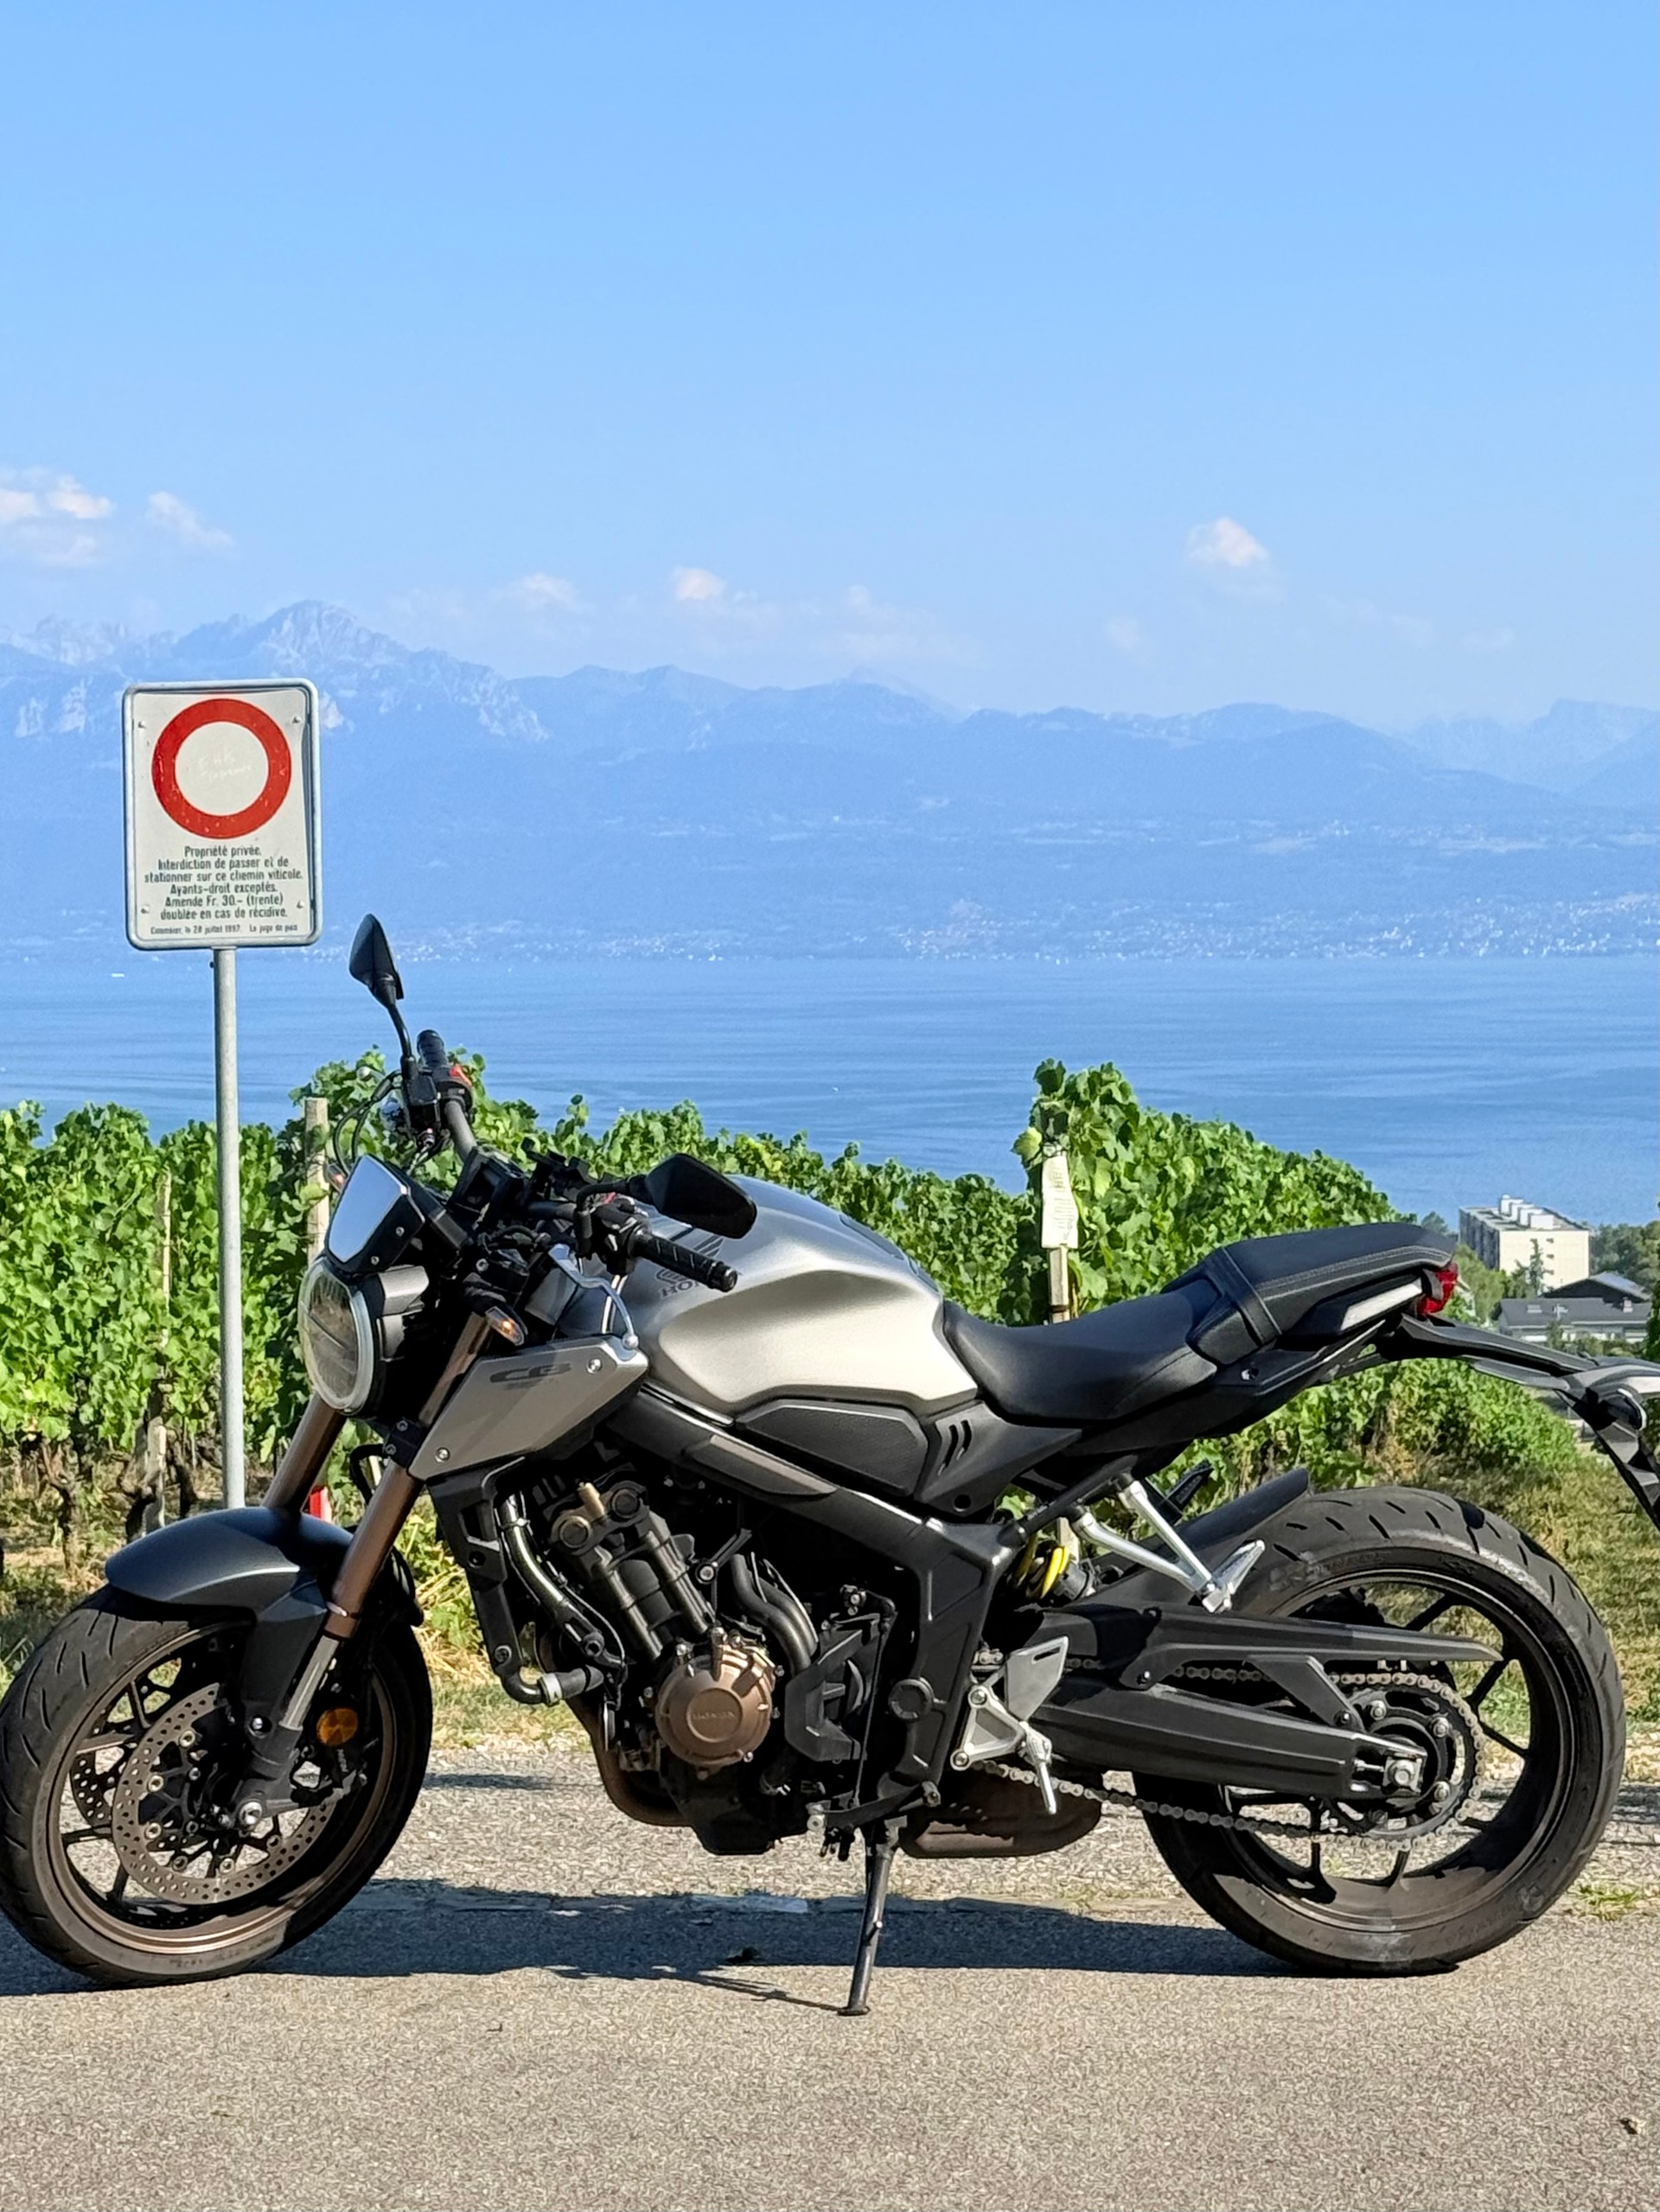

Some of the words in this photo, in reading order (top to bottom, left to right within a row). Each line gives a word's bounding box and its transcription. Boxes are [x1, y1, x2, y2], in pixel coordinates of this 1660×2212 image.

[184, 845, 228, 858] Propriété
[158, 858, 211, 870] Interdiction
[214, 857, 226, 869] de
[229, 859, 260, 871] passer
[278, 855, 289, 867] de
[144, 871, 193, 883] stationner
[196, 872, 212, 883] sur
[215, 872, 227, 882] ce
[230, 869, 265, 882] chemin
[170, 882, 231, 897] Ayants-droit
[165, 896, 203, 908] Amende
[246, 892, 284, 907] (trente)
[161, 908, 198, 921] doublée
[200, 910, 212, 920] en
[214, 909, 232, 919] cas
[234, 906, 246, 919] de
